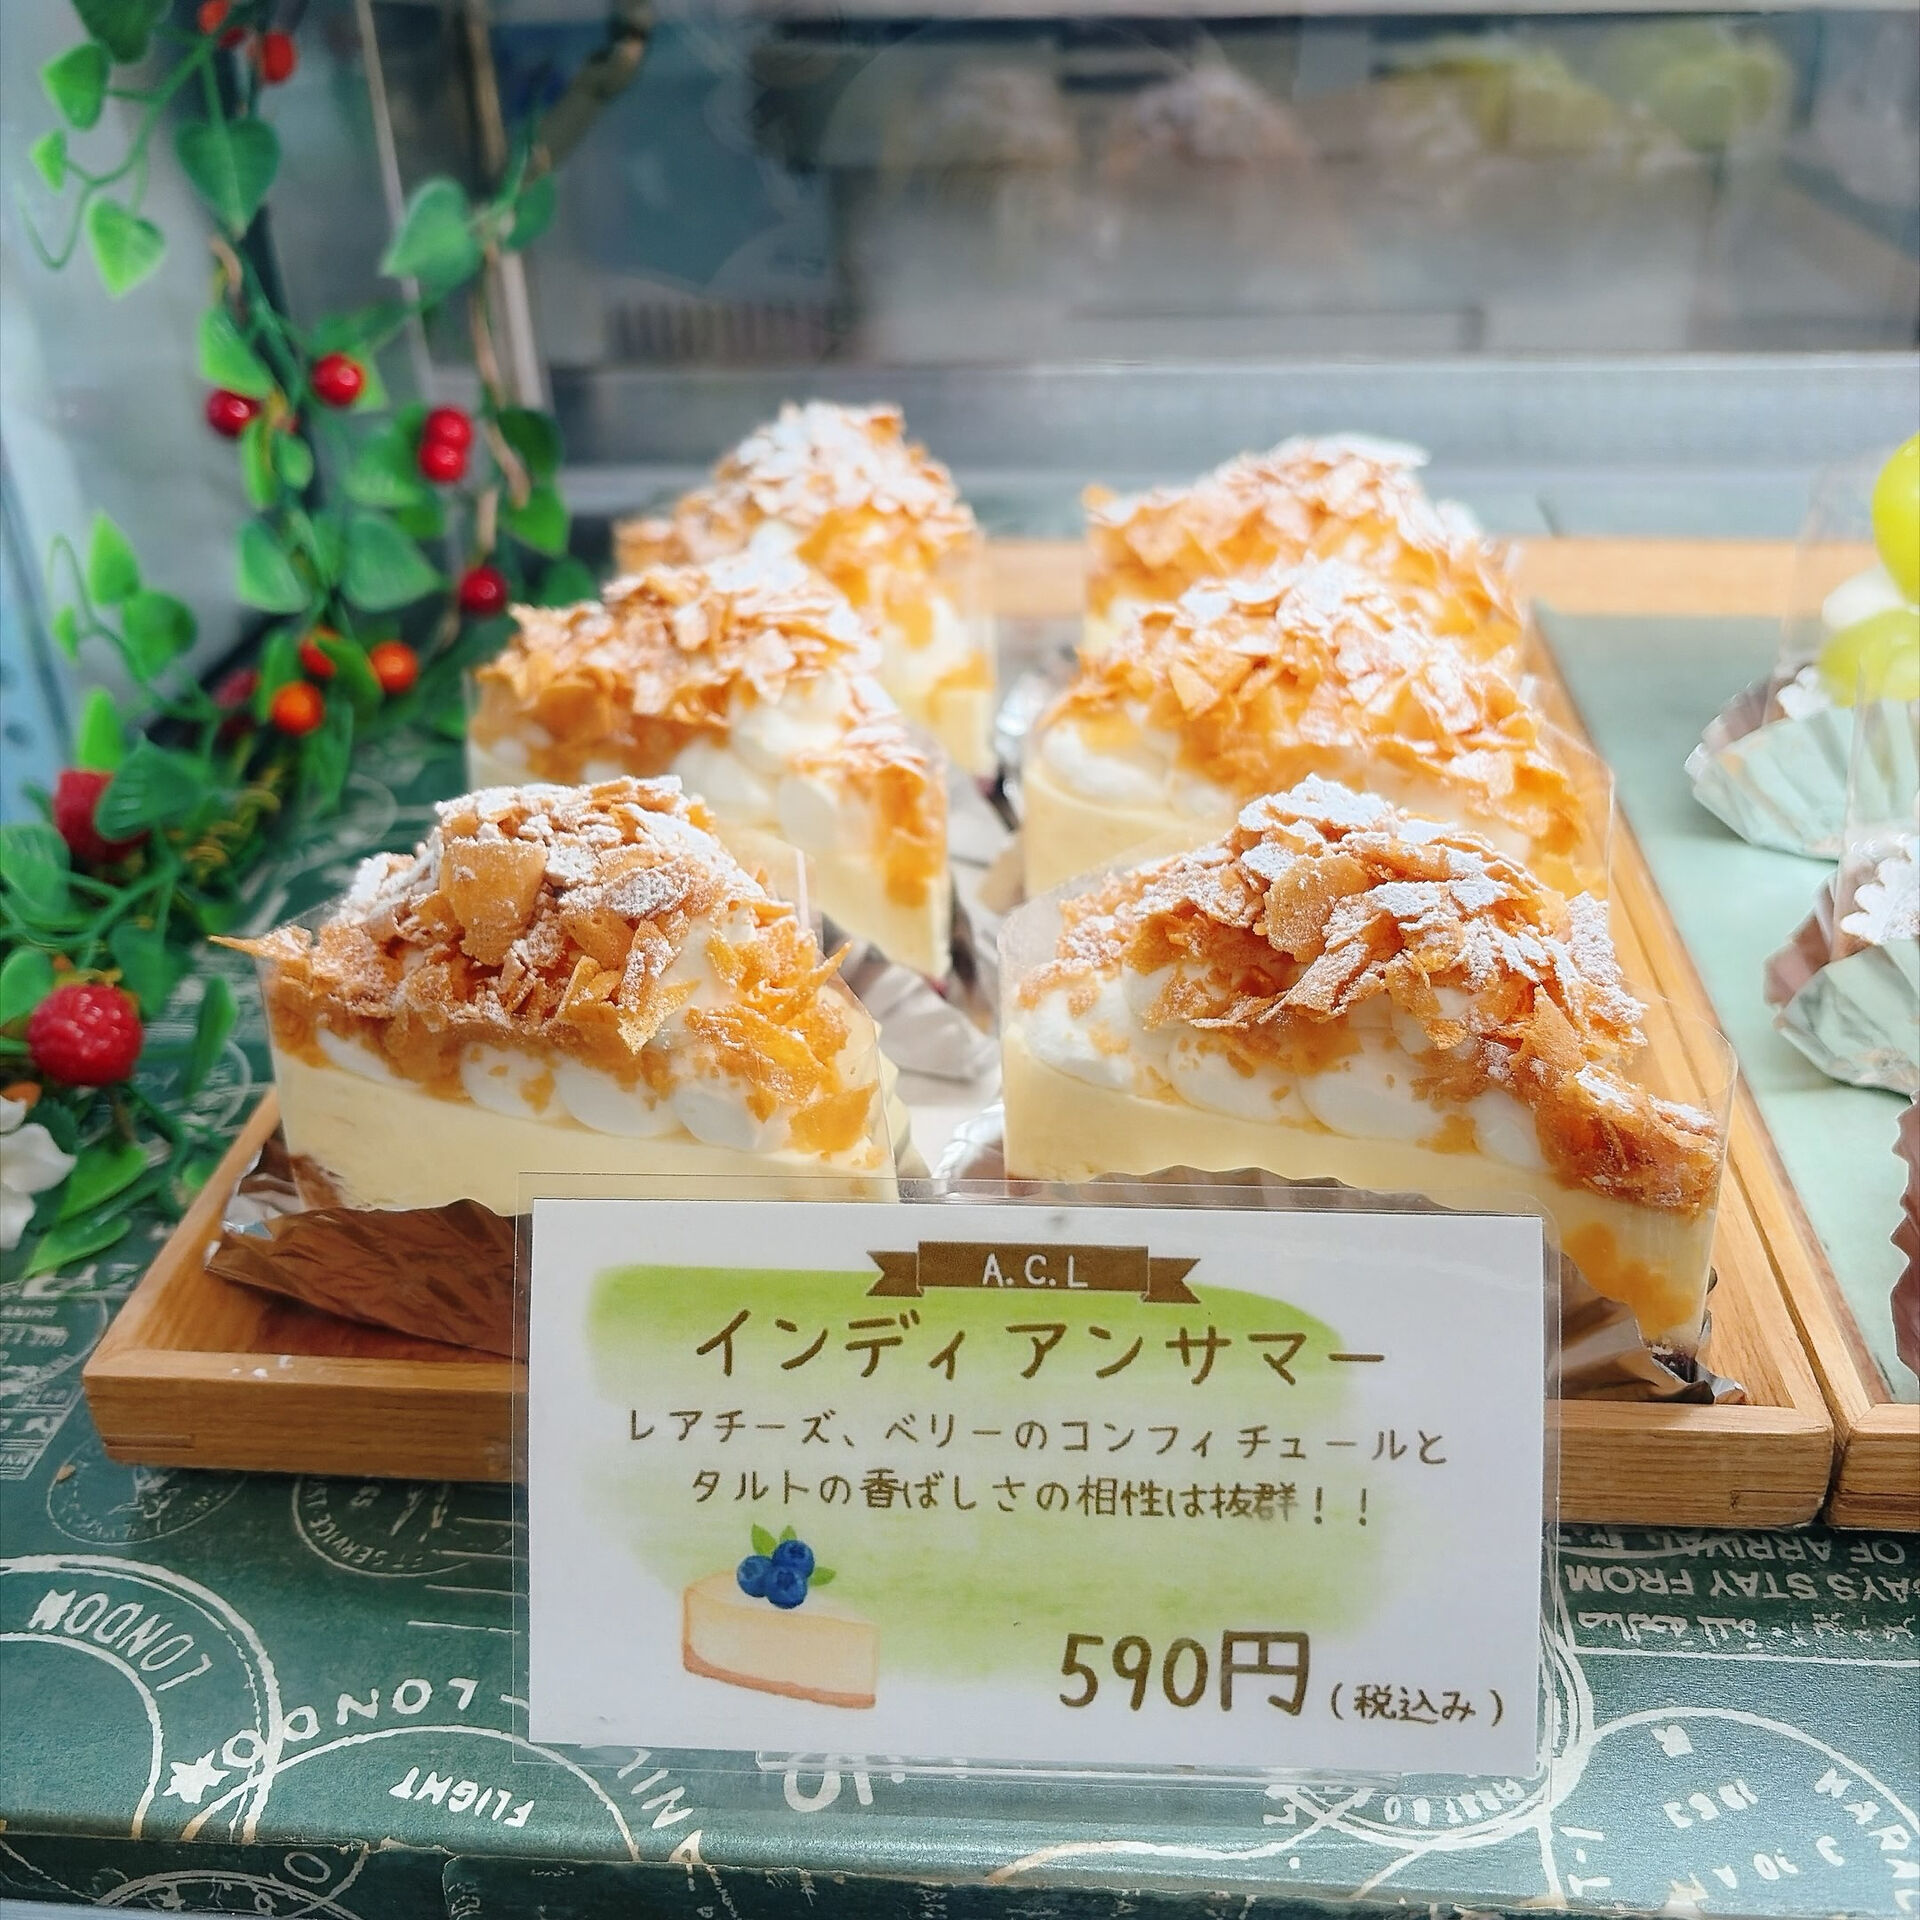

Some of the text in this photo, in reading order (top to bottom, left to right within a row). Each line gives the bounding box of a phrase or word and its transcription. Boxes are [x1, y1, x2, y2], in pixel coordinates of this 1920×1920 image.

[983, 1254, 1088, 1288] A.C.L
[695, 1307, 1387, 1387] インディアンサマー
[629, 1408, 1449, 1466] レアチーズ、ベリーのコンフィチュールと
[692, 1468, 1369, 1527] タルトの香ばしさの相性は抜群！！
[1849, 1538, 1906, 1566] OF
[1564, 1564, 1920, 1604] AYS STAY FROM
[1059, 1628, 1505, 1728] 590円 (税込み)
[388, 1766, 536, 1829] FLIGHT
